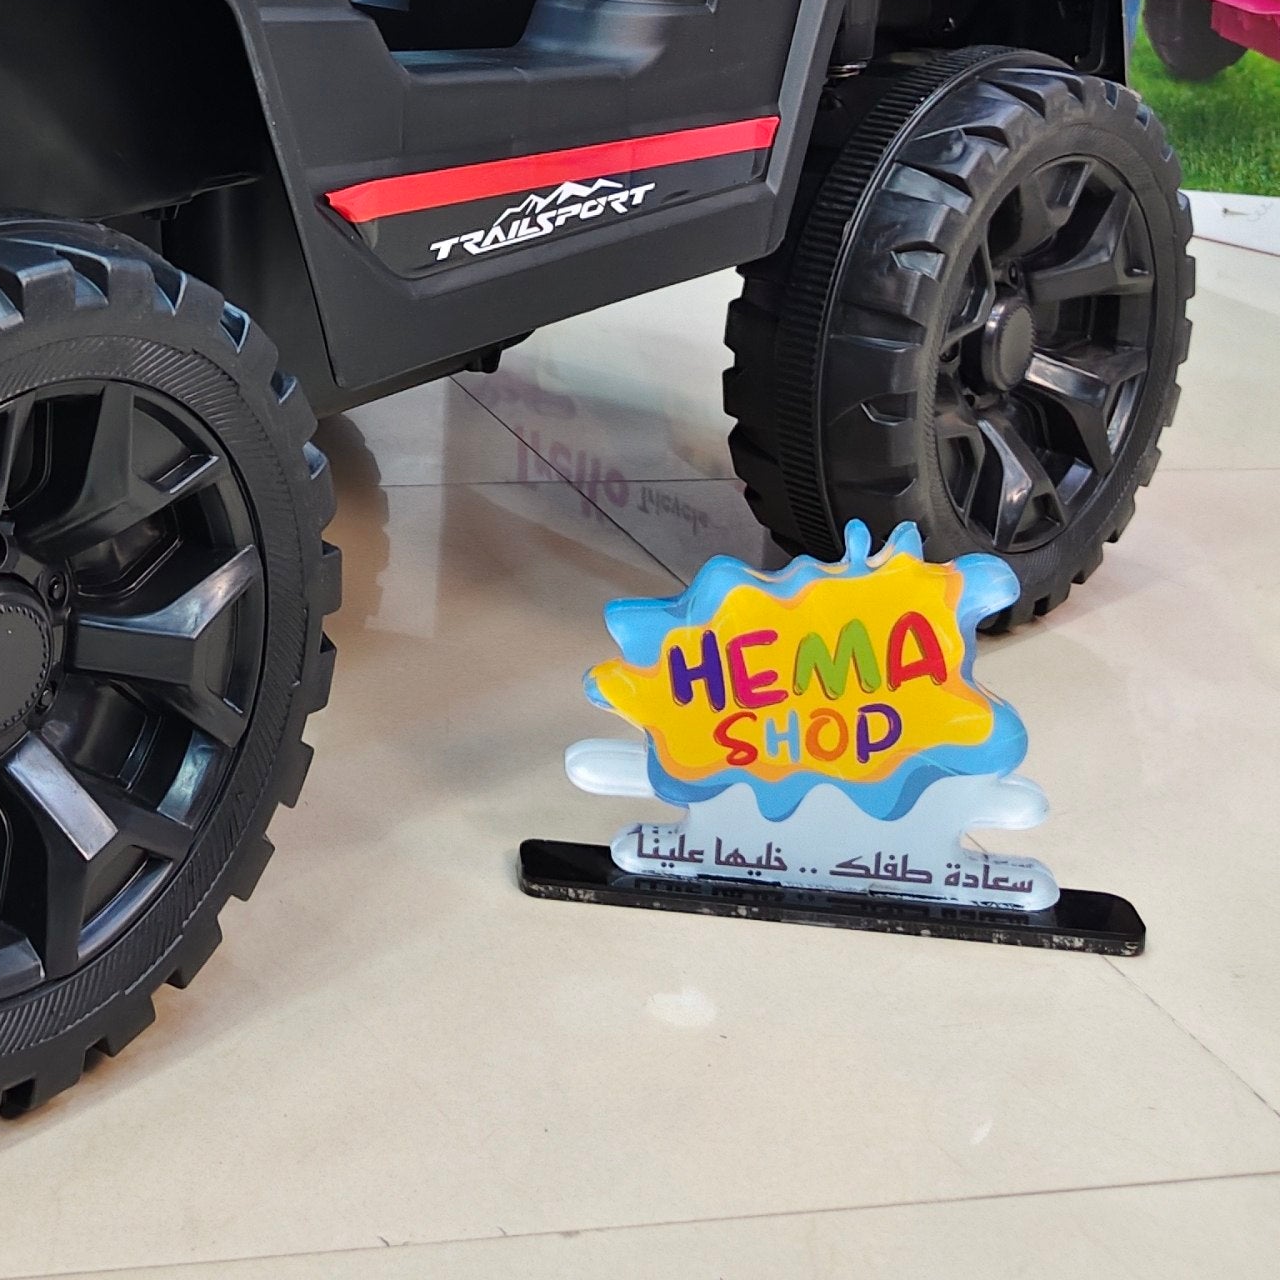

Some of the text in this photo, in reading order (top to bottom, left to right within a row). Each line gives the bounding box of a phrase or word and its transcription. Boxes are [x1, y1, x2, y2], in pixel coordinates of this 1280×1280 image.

[430, 183, 655, 261] TRAILSPORT
[667, 610, 947, 712] HEMA
[713, 703, 903, 766] SHOP
[636, 832, 705, 869] علينا
[715, 836, 787, 877] خليها
[829, 850, 933, 886] طفلك
[944, 862, 1034, 894] سعادة
